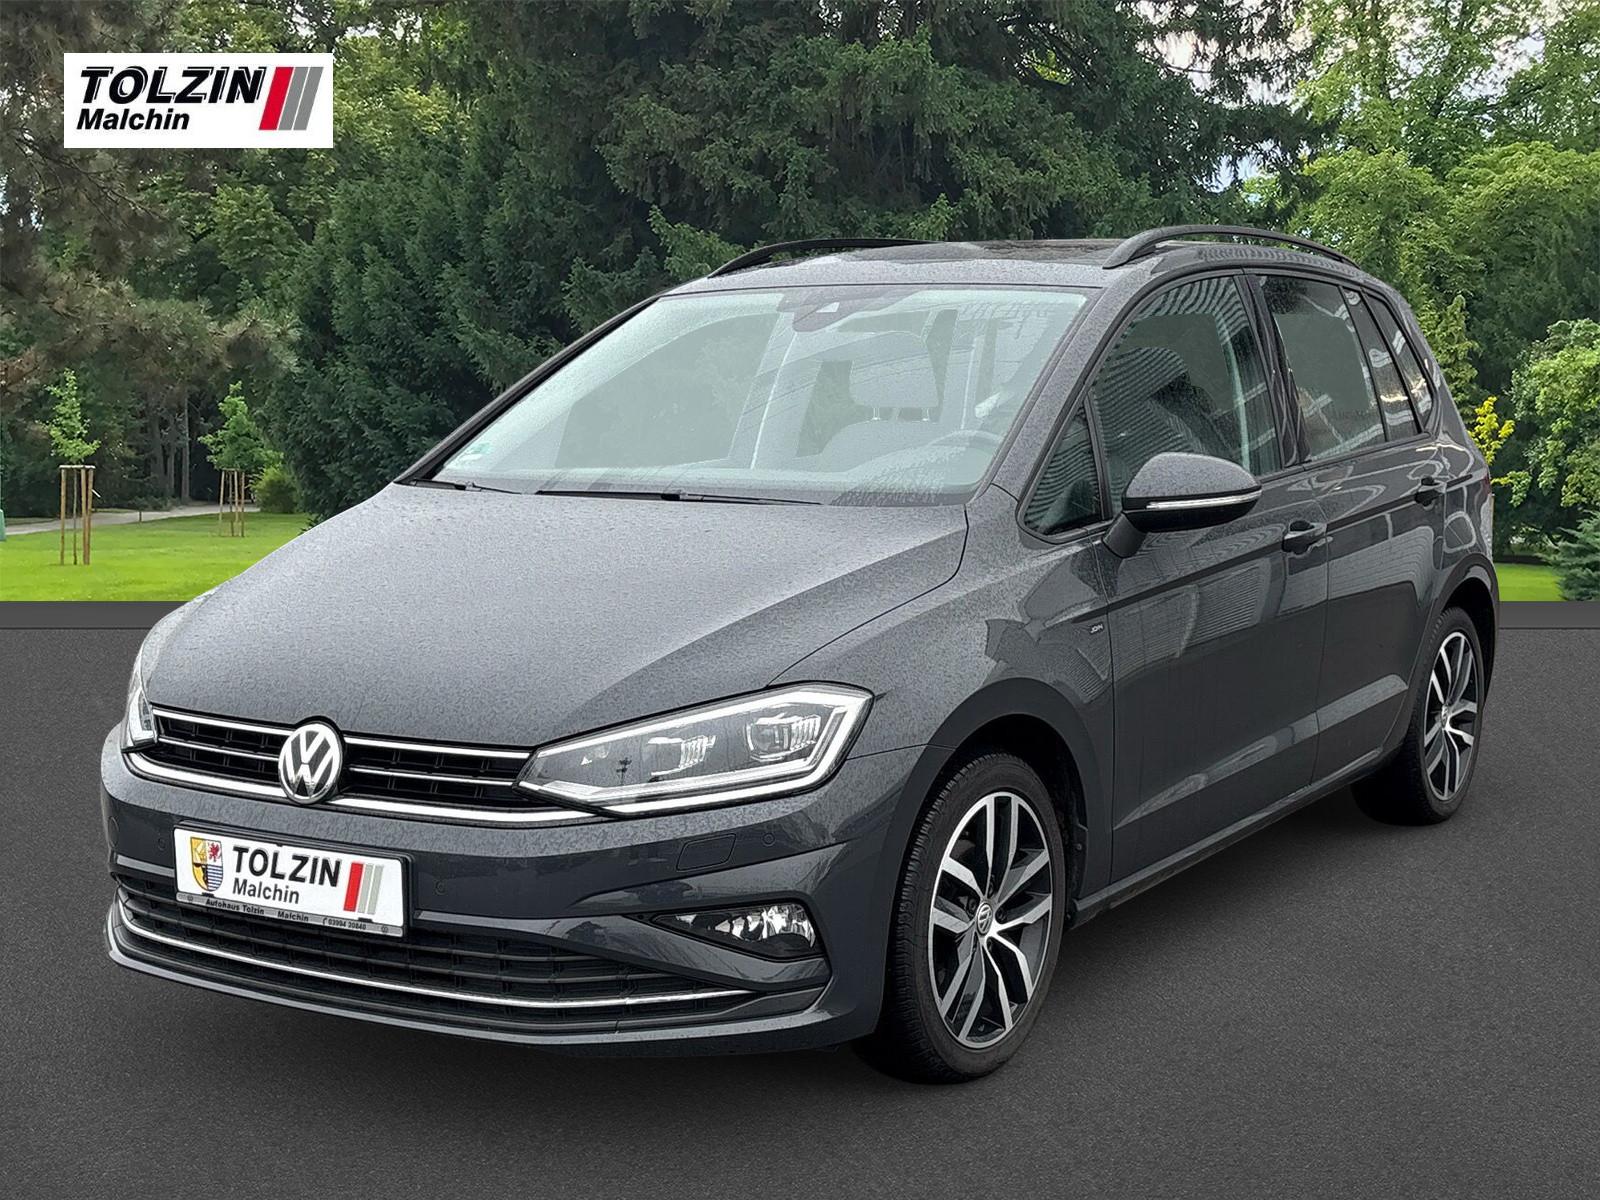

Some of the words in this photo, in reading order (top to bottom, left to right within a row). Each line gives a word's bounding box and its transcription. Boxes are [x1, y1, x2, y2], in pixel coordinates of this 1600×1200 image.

[233, 845, 342, 887] TOLZIN
[232, 877, 300, 904] Malchin
[205, 898, 240, 912] Autohaus
[242, 904, 265, 915] Tolzin
[277, 910, 309, 922] Malchin
